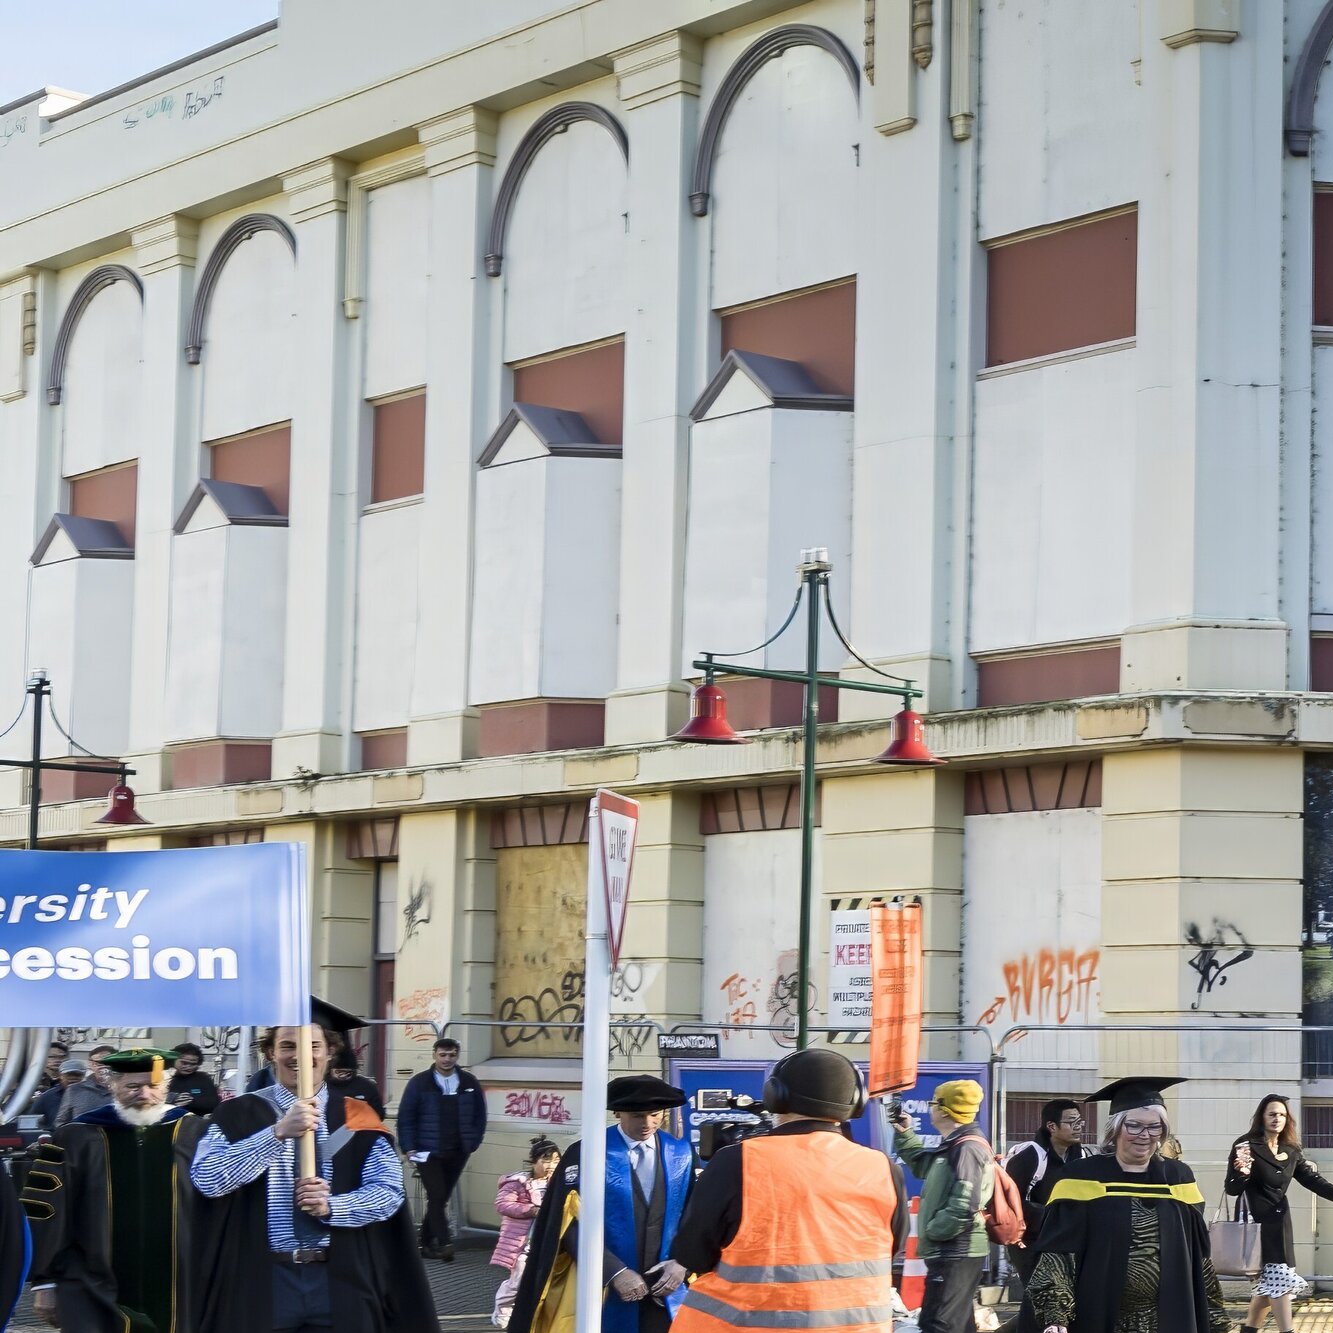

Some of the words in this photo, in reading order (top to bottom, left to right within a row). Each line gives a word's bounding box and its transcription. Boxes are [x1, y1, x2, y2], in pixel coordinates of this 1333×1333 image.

[0, 884, 149, 928] rsity
[0, 935, 238, 980] ession
[659, 1035, 717, 1048] PHANTOM
